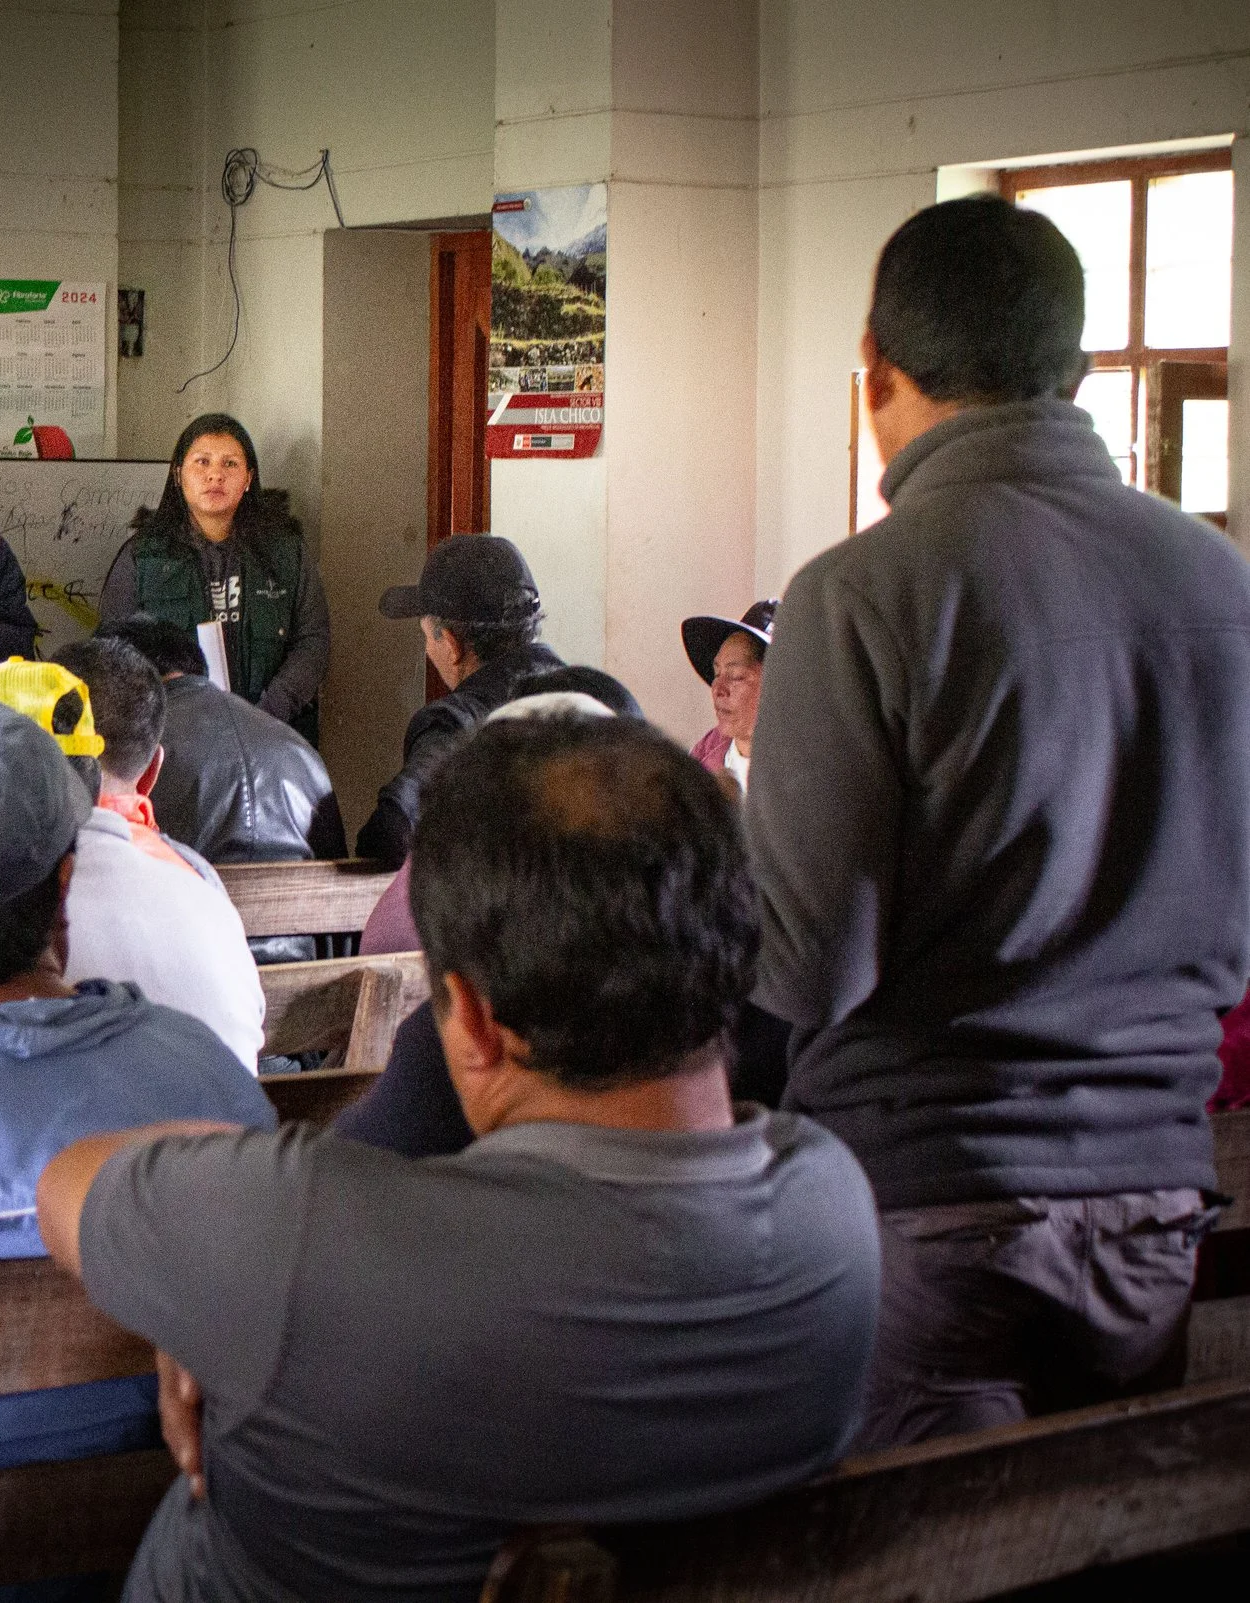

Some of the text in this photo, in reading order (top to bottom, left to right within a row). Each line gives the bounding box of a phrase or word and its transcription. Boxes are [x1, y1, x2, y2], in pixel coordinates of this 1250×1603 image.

[62, 291, 97, 304] 2024
[534, 406, 601, 424] ISLA CHICO
